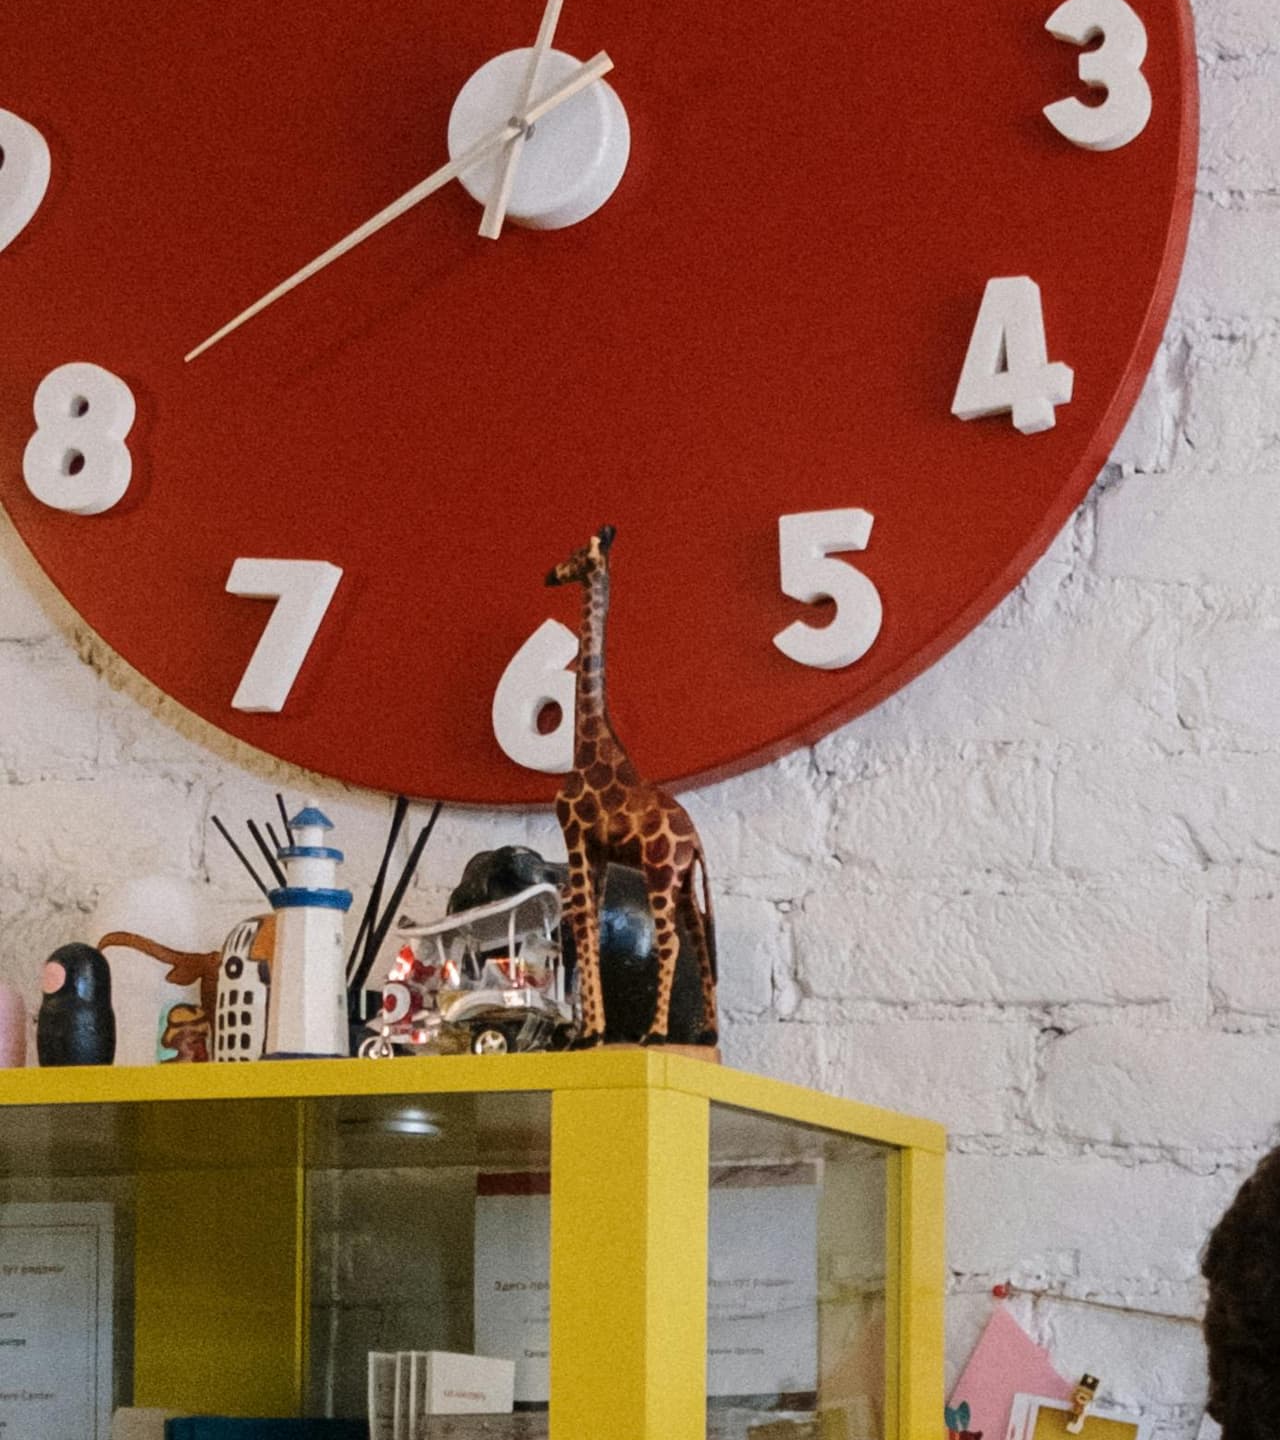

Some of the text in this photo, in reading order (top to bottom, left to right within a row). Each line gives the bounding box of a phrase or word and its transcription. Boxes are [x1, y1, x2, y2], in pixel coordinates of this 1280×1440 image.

[950, 275, 1074, 434] 4
[22, 362, 136, 515] 8
[225, 557, 343, 712] 7
[773, 508, 883, 670] 5
[491, 618, 580, 773] 6
